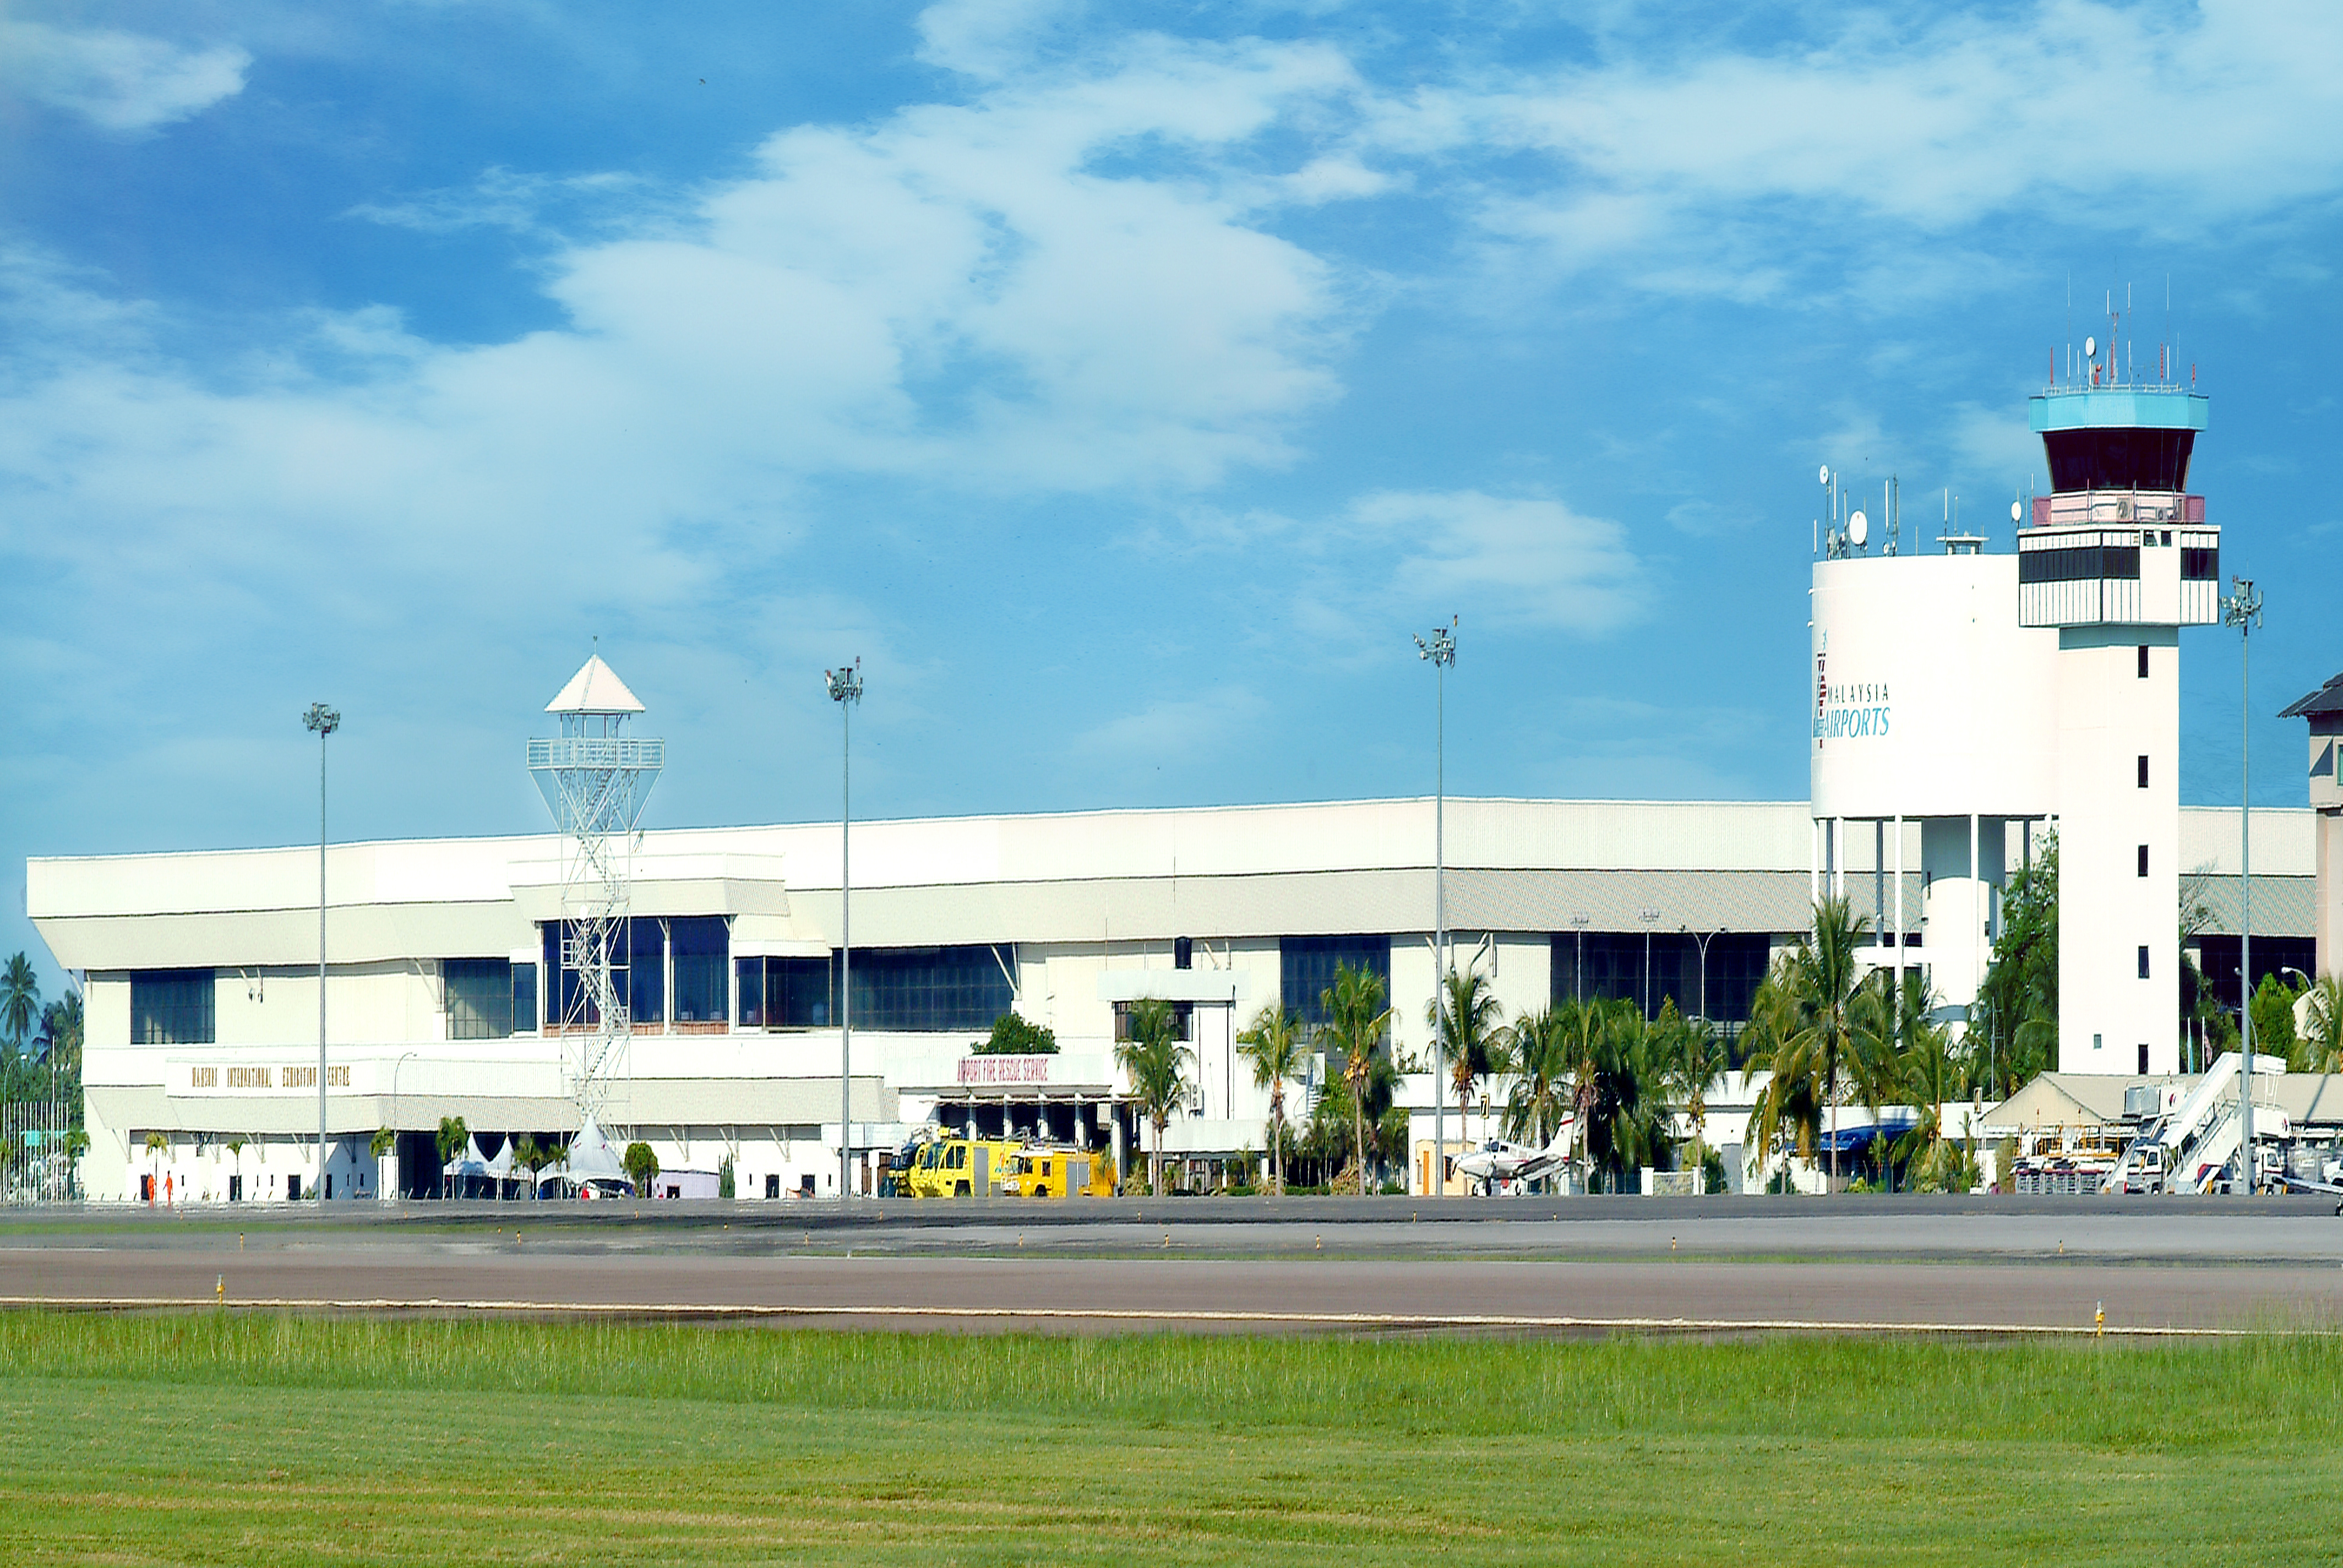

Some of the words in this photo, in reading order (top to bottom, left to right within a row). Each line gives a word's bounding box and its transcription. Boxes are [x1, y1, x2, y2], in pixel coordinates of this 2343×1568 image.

[1828, 683, 1888, 704] MALAYSIA
[1823, 707, 1890, 738] AIRPORTS
[227, 1066, 272, 1088] INTERNATIONAL
[283, 1066, 317, 1088] EXHIBITION
[328, 1065, 350, 1087] CENTRE
[957, 1059, 981, 1082] AIRPORT
[983, 1058, 996, 1082] FIRE
[999, 1058, 1021, 1082] RESCUE
[1023, 1057, 1048, 1081] SERVICE
